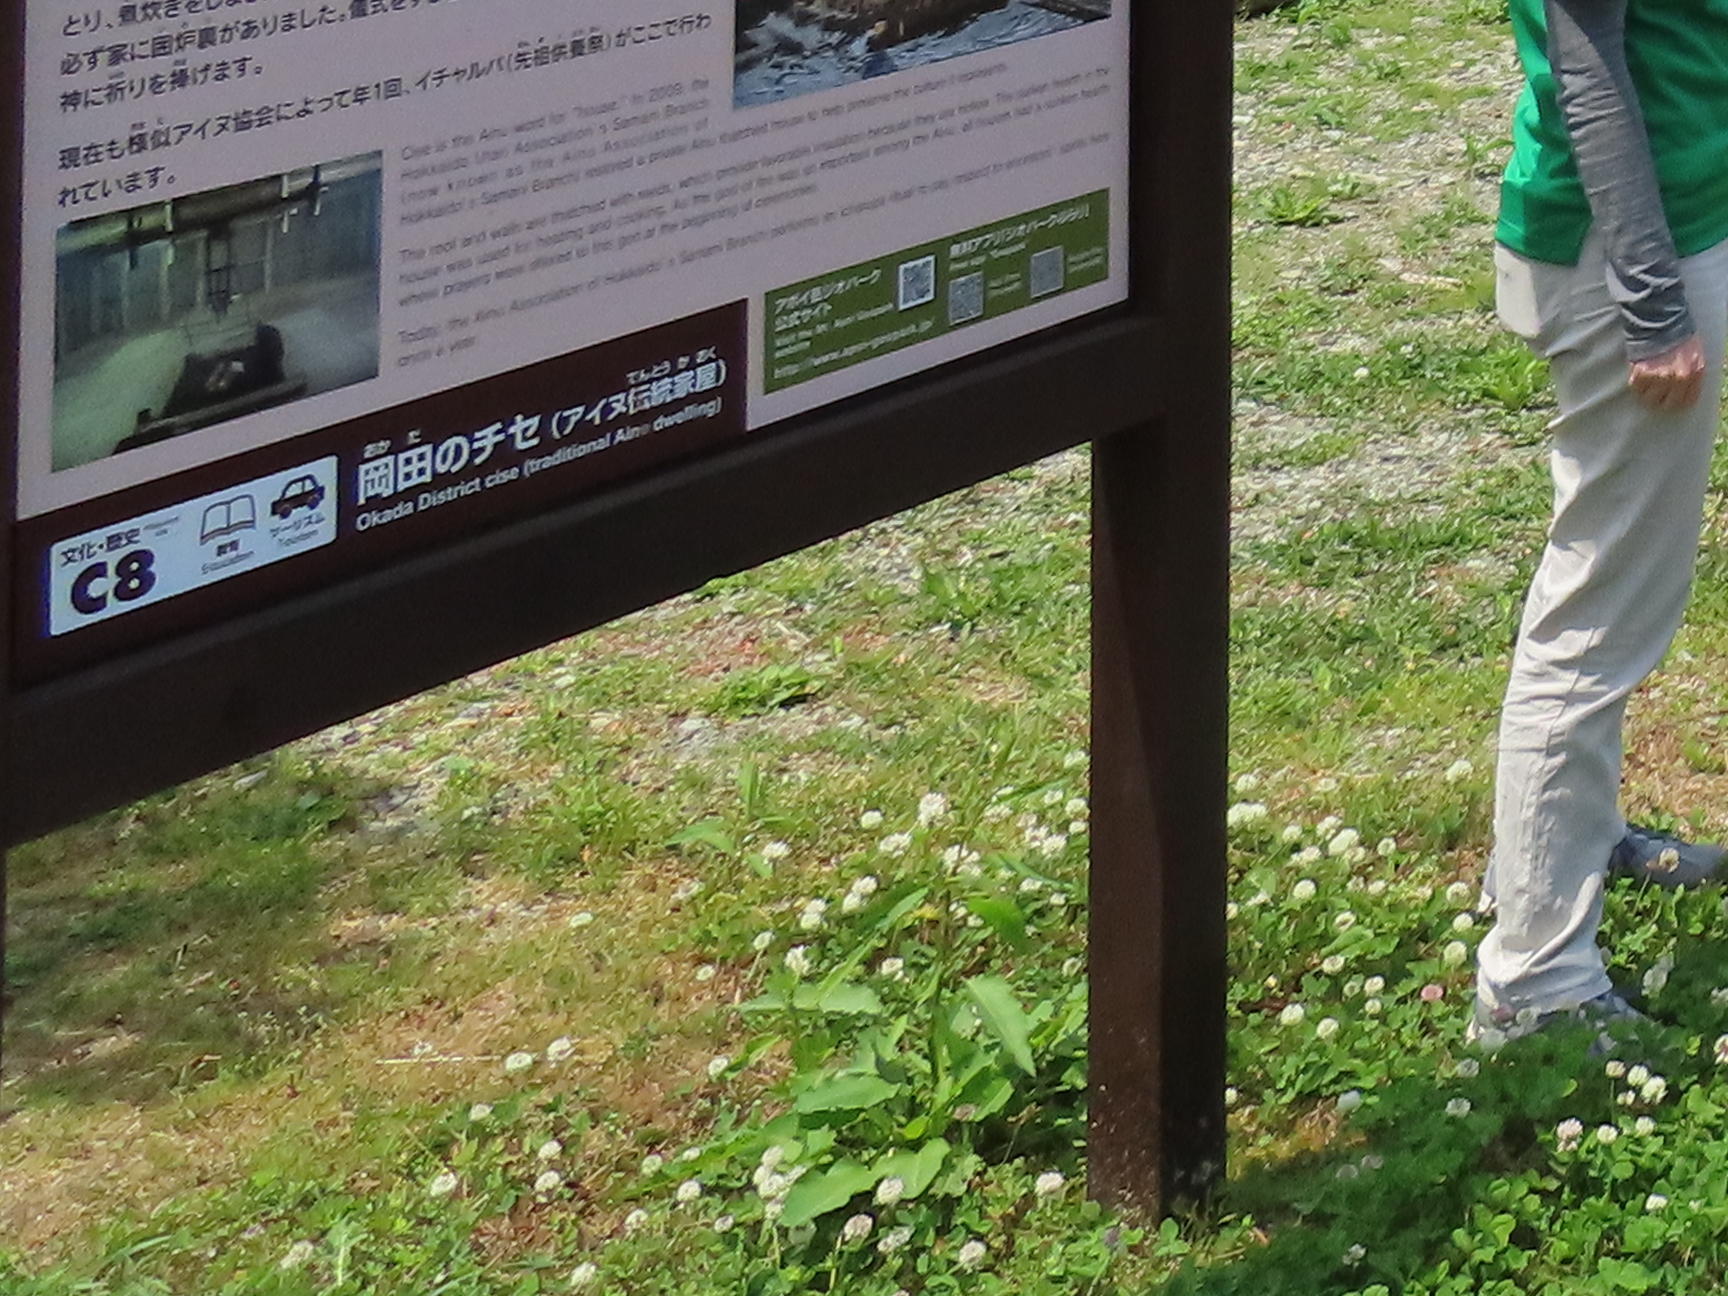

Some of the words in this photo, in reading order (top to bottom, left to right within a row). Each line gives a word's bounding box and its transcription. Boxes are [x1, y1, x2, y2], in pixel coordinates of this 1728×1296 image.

[57, 166, 177, 208] れています。
[355, 499, 415, 532] Okada
[416, 476, 483, 507] District
[523, 436, 612, 478] (traditional
[652, 396, 723, 433] dwelling)
[357, 413, 541, 506] 岡田のチセ
[551, 358, 727, 440] (アイヌ伝統家屋)
[70, 548, 156, 616] C8
